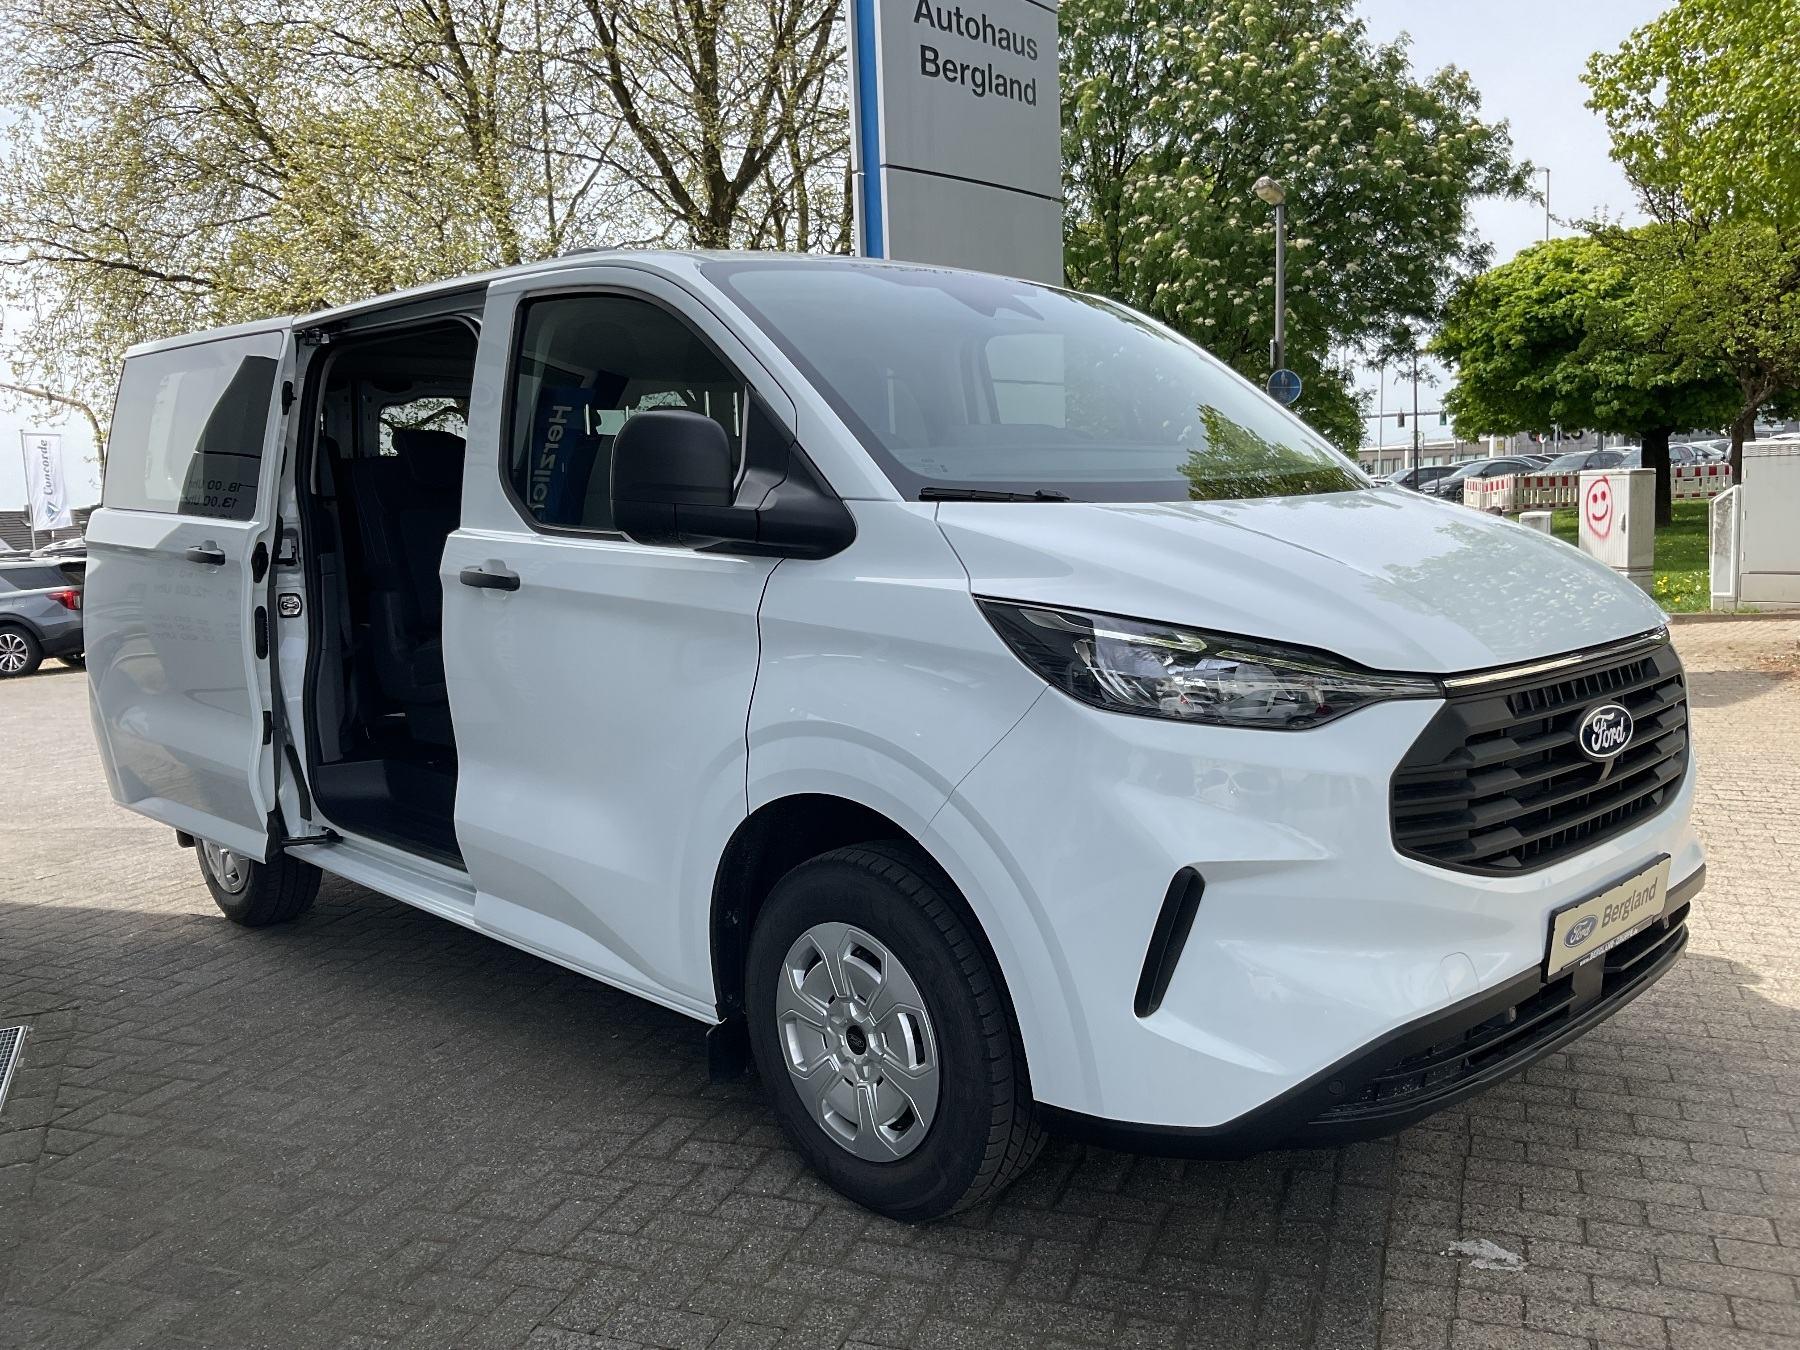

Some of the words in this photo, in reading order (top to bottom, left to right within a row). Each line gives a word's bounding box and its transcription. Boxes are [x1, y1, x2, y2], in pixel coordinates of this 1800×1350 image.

[913, 0, 1038, 61] Autohaus
[919, 44, 1037, 107] Bergland
[37, 439, 53, 496] Concorde
[1591, 712, 1626, 752] Ford
[1601, 877, 1658, 928] Bergland
